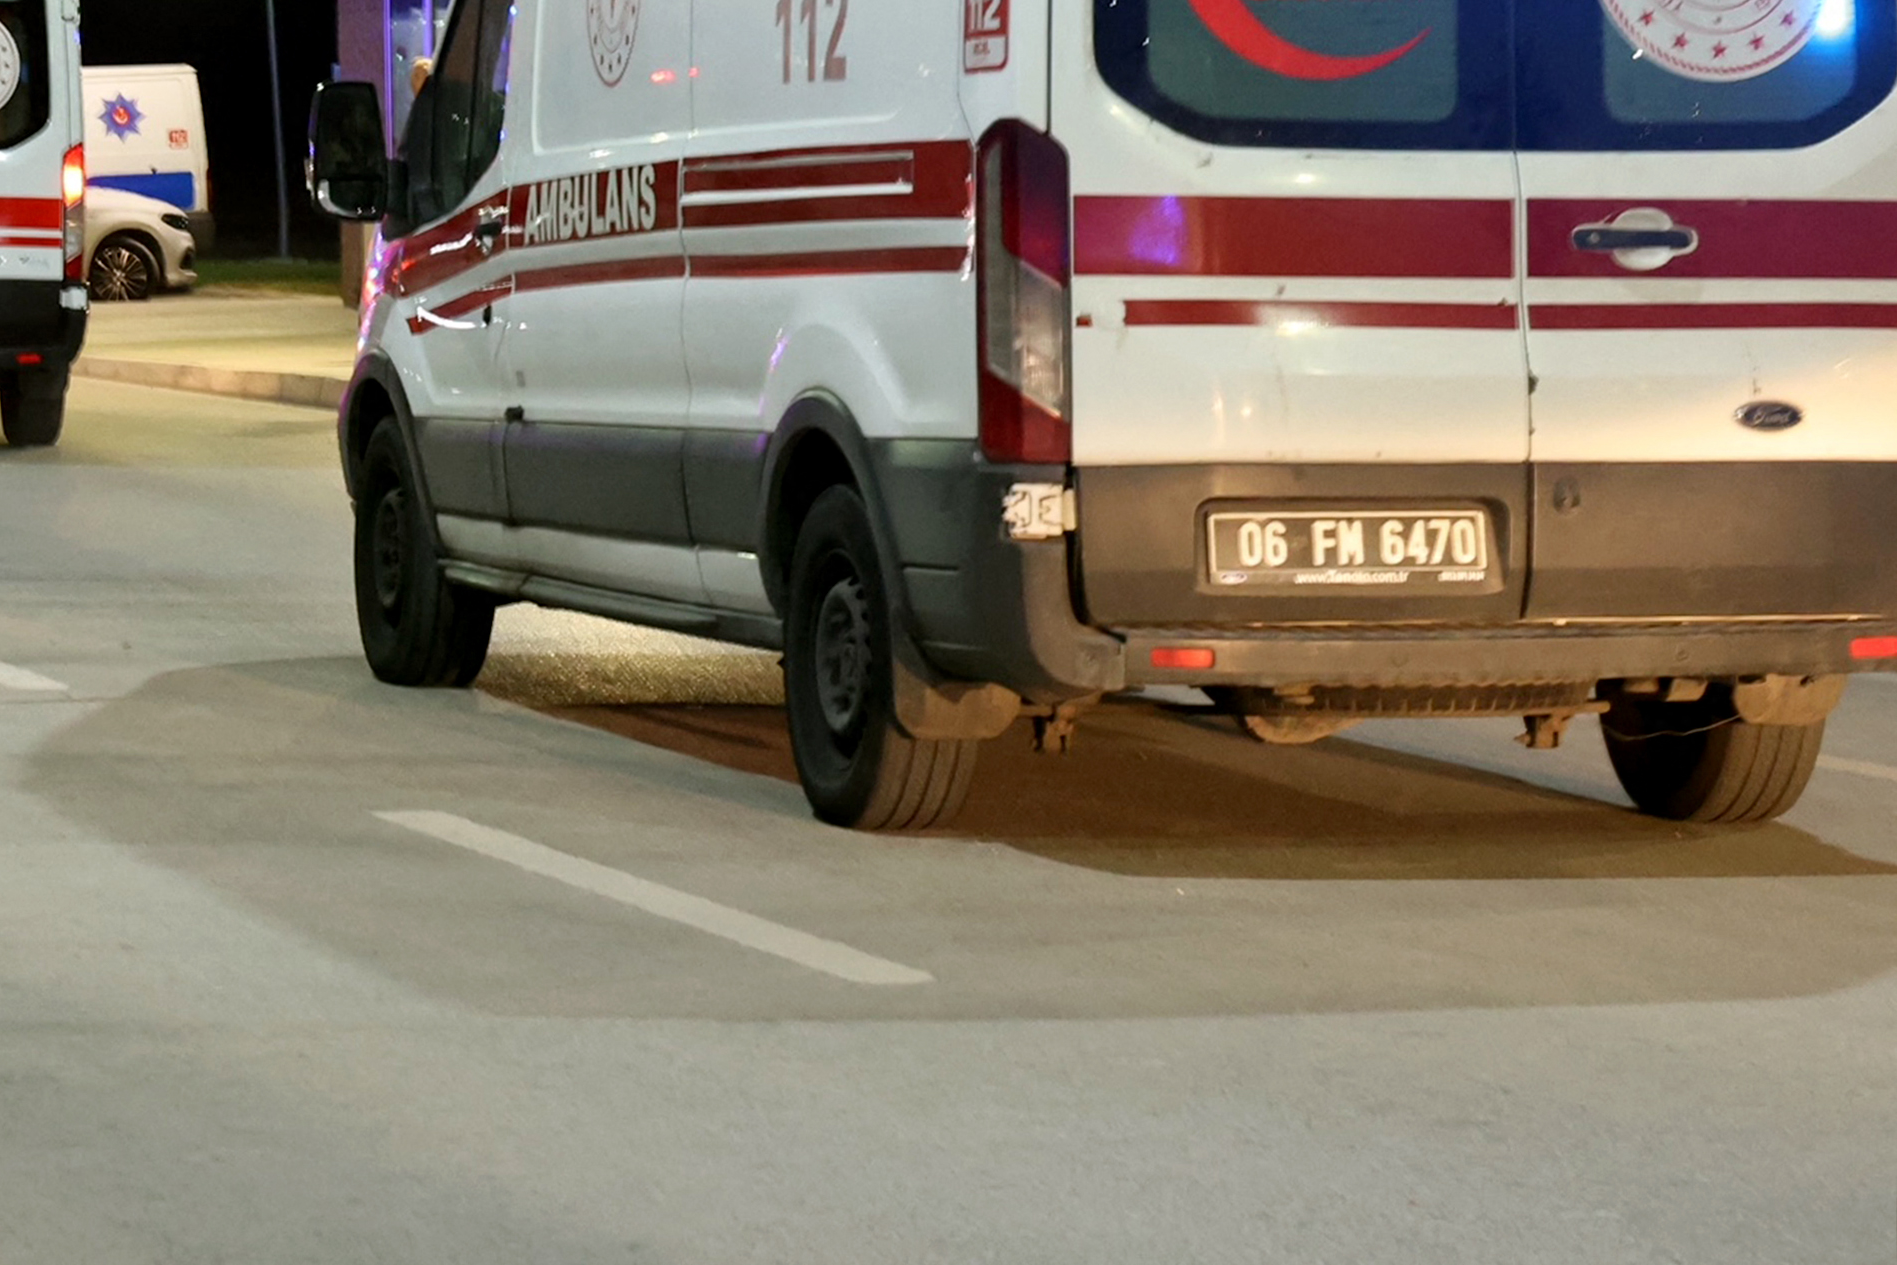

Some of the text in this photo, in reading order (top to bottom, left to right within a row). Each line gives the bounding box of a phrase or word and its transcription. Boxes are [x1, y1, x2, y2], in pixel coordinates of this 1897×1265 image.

[524, 163, 657, 246] AMBULANS
[1237, 519, 1477, 567] 06 FM 6470
